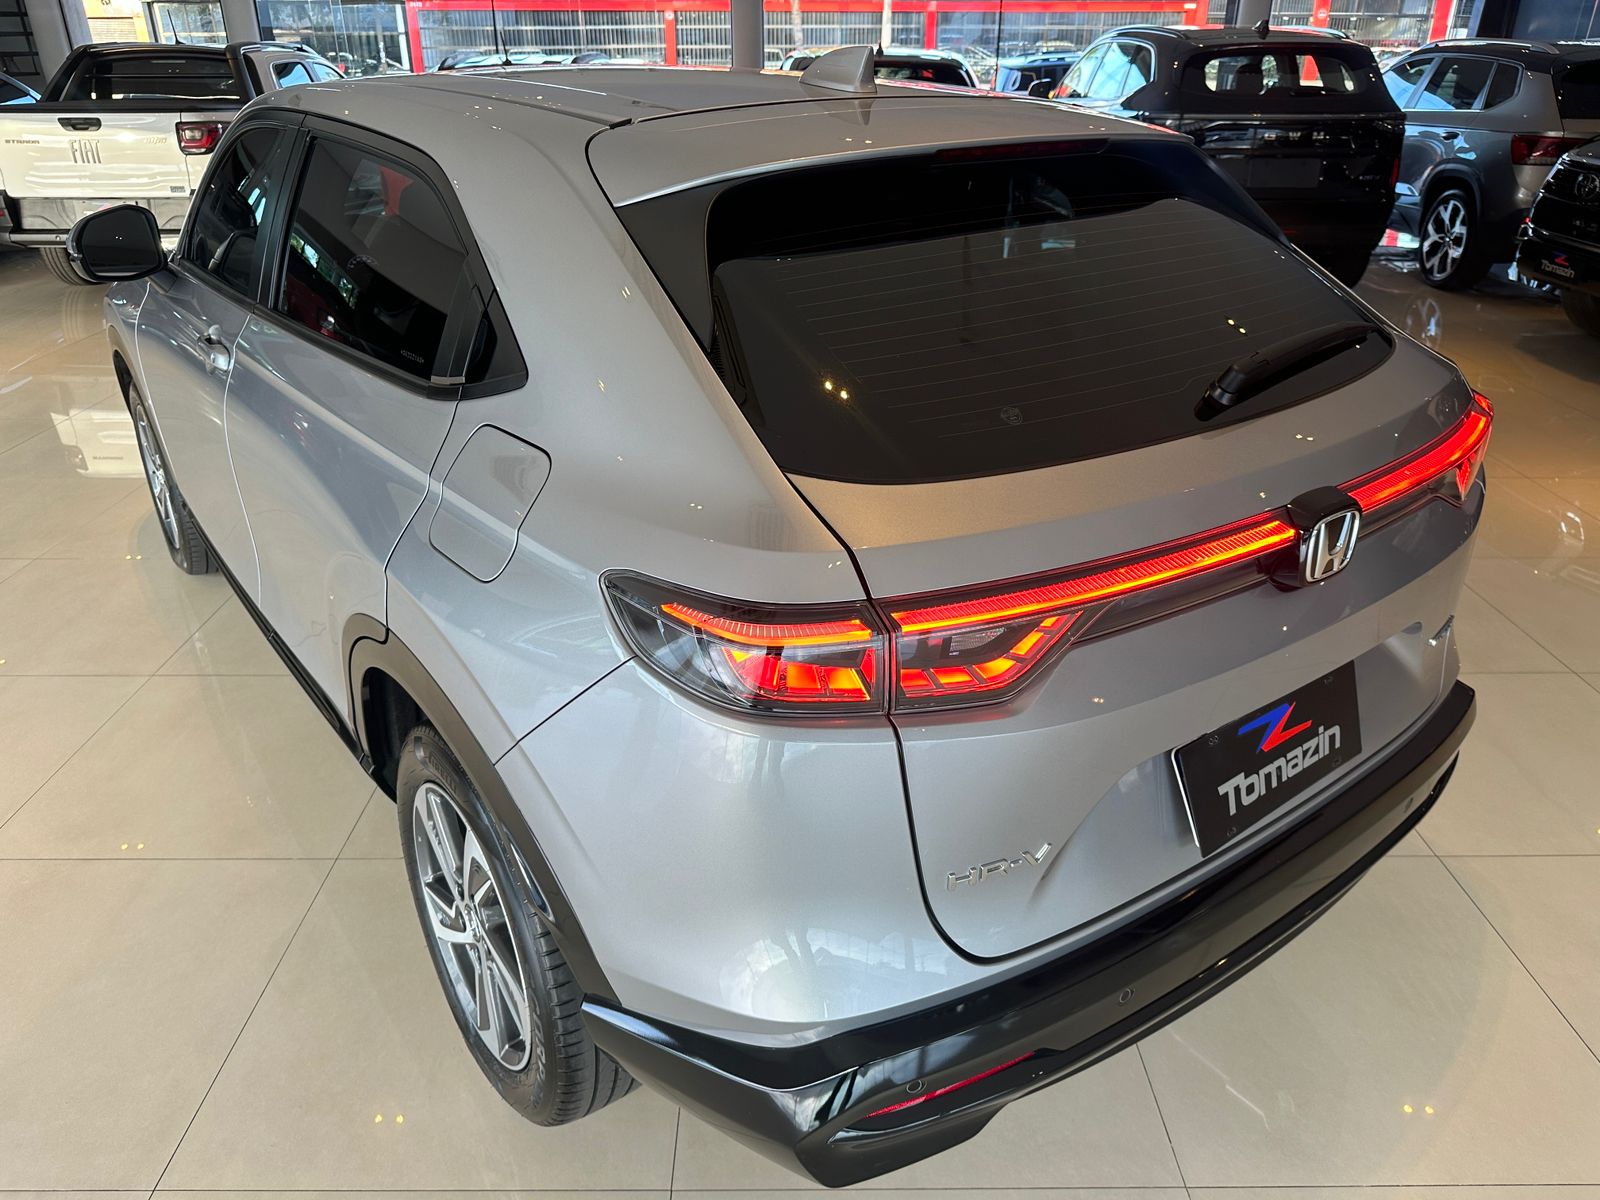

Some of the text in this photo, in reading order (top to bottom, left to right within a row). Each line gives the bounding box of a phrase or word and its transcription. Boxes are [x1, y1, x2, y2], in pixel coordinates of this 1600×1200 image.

[69, 138, 103, 164] FIAT
[1217, 724, 1342, 817] Tomazin
[945, 842, 1053, 892] HR-V
